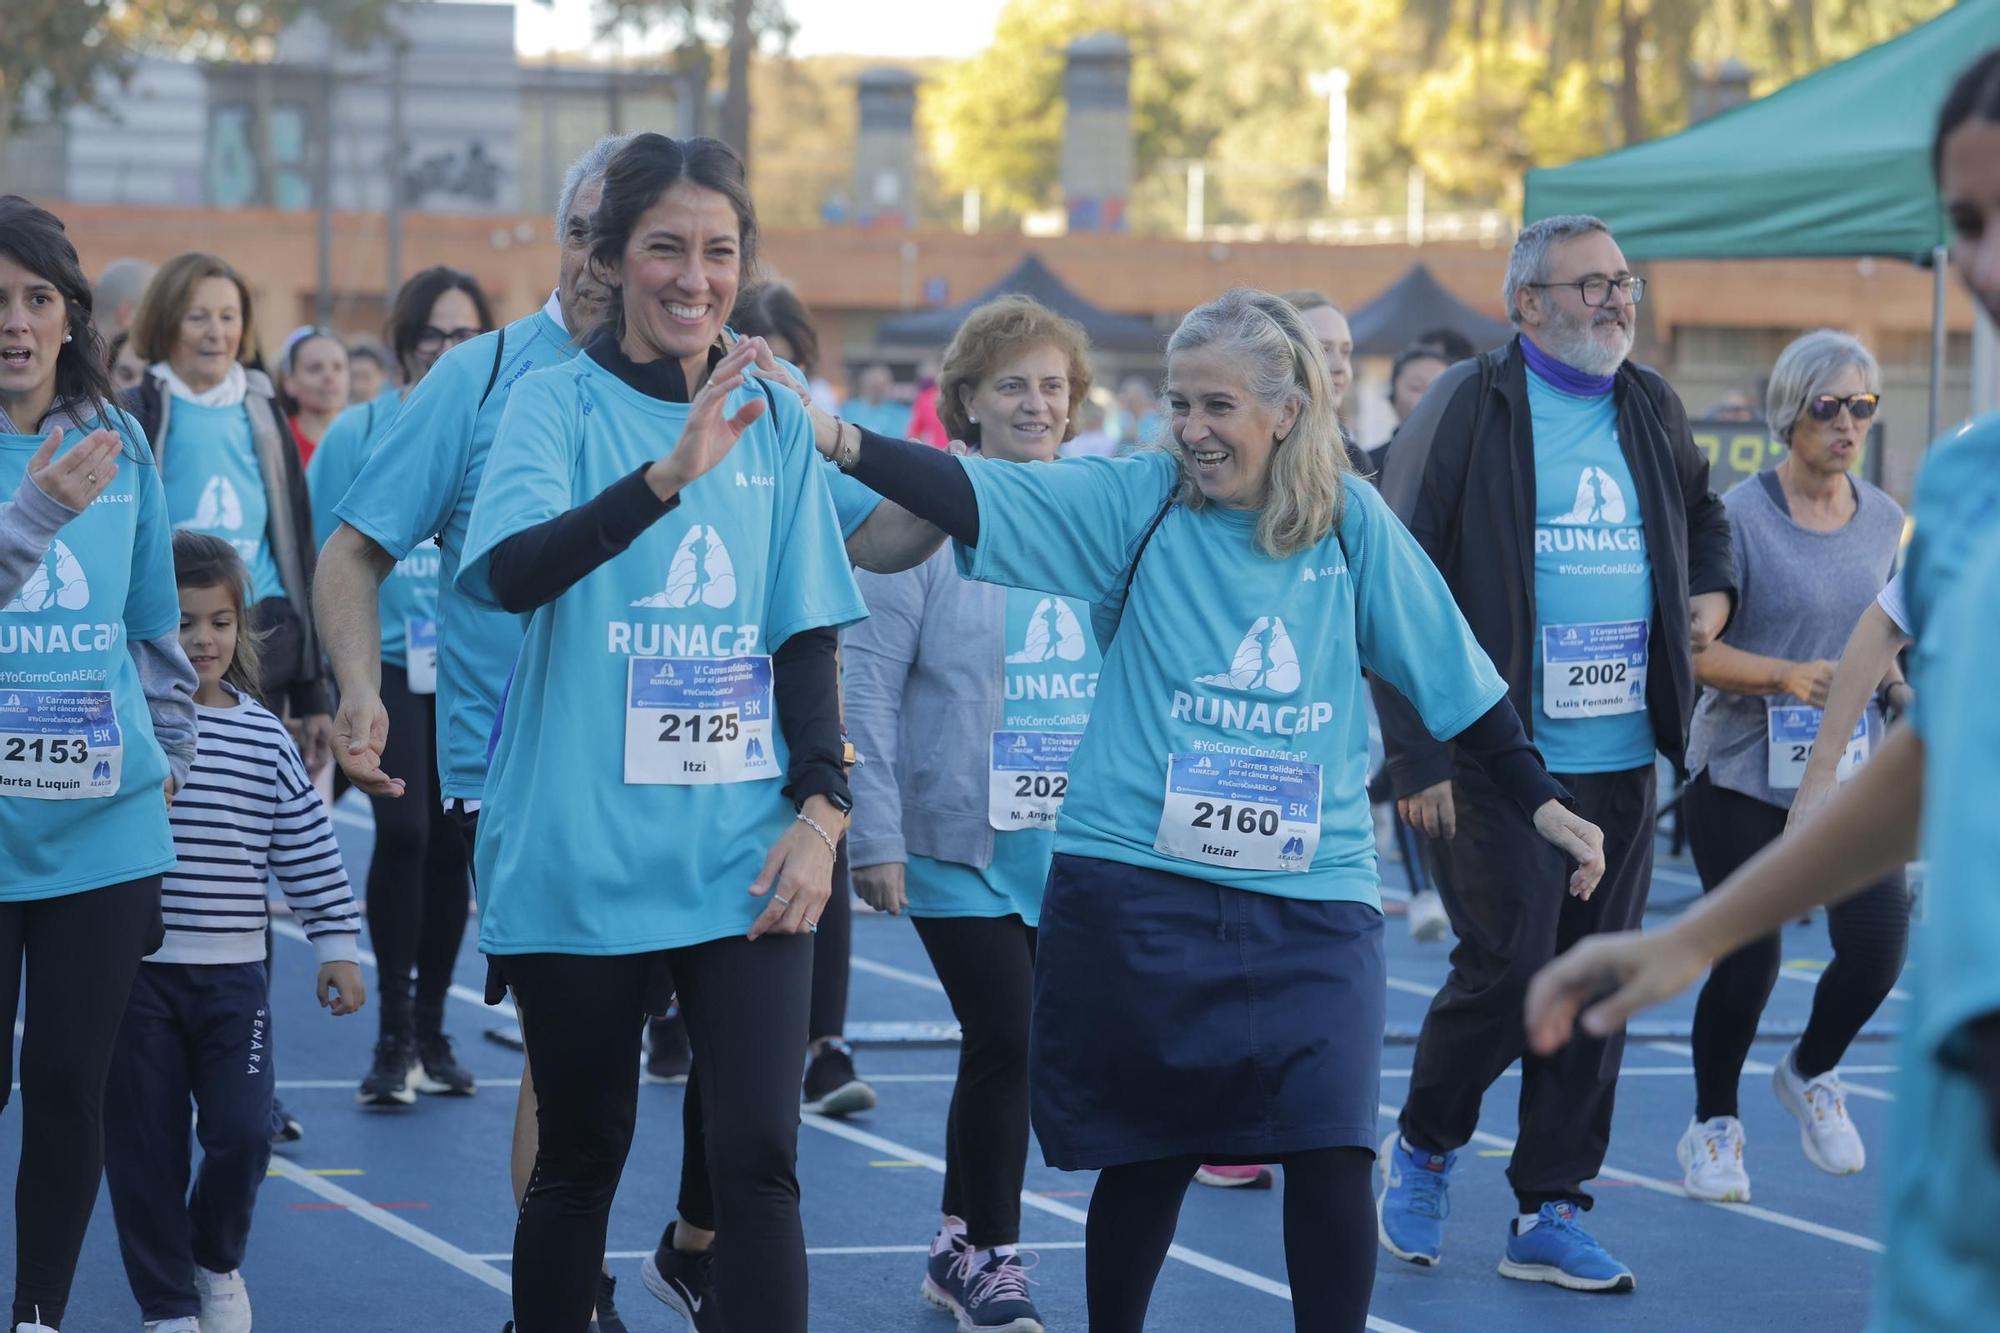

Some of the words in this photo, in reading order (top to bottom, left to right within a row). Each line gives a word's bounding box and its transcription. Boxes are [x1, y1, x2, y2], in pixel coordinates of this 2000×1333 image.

[0, 622, 118, 654] UNACaP
[1568, 663, 1626, 687] 2002
[1005, 673, 1099, 701] UNACa
[46, 695, 76, 705] Carrera
[745, 701, 761, 715] 5K
[1170, 689, 1333, 736] RUNACaP
[93, 729, 112, 743] 5K
[658, 713, 739, 743] 2125
[5, 737, 89, 764] 2153
[683, 761, 706, 772] Itzi
[1228, 769, 1240, 777] por
[1229, 759, 1236, 768] V
[1237, 760, 1268, 772] Carrera
[0, 775, 32, 789] arta
[1015, 775, 1068, 798] 202
[1011, 811, 1025, 821] M.
[1288, 801, 1308, 817] 5K
[1191, 801, 1280, 837] 2160
[1201, 842, 1240, 858] Itziar
[247, 1009, 266, 1074] SENARA
